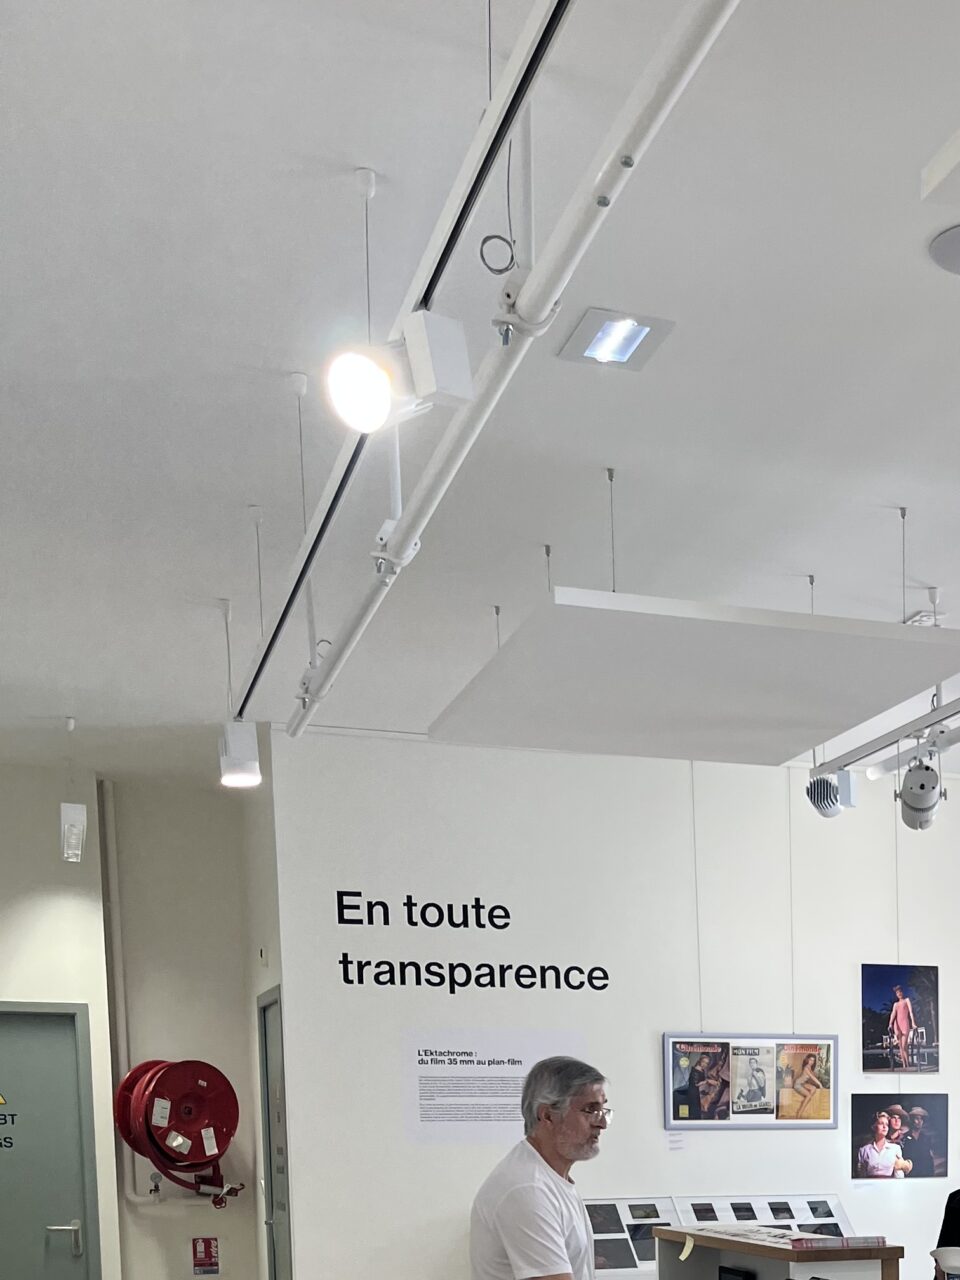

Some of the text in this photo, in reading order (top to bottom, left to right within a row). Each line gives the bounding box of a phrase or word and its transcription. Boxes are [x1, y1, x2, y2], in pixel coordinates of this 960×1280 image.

[336, 890, 511, 930] En toute
[338, 952, 610, 995] transparence
[417, 1049, 473, 1057] L'Ektachrome
[417, 1057, 428, 1065] du
[430, 1057, 446, 1065] film
[487, 1058, 523, 1067] plan-film
